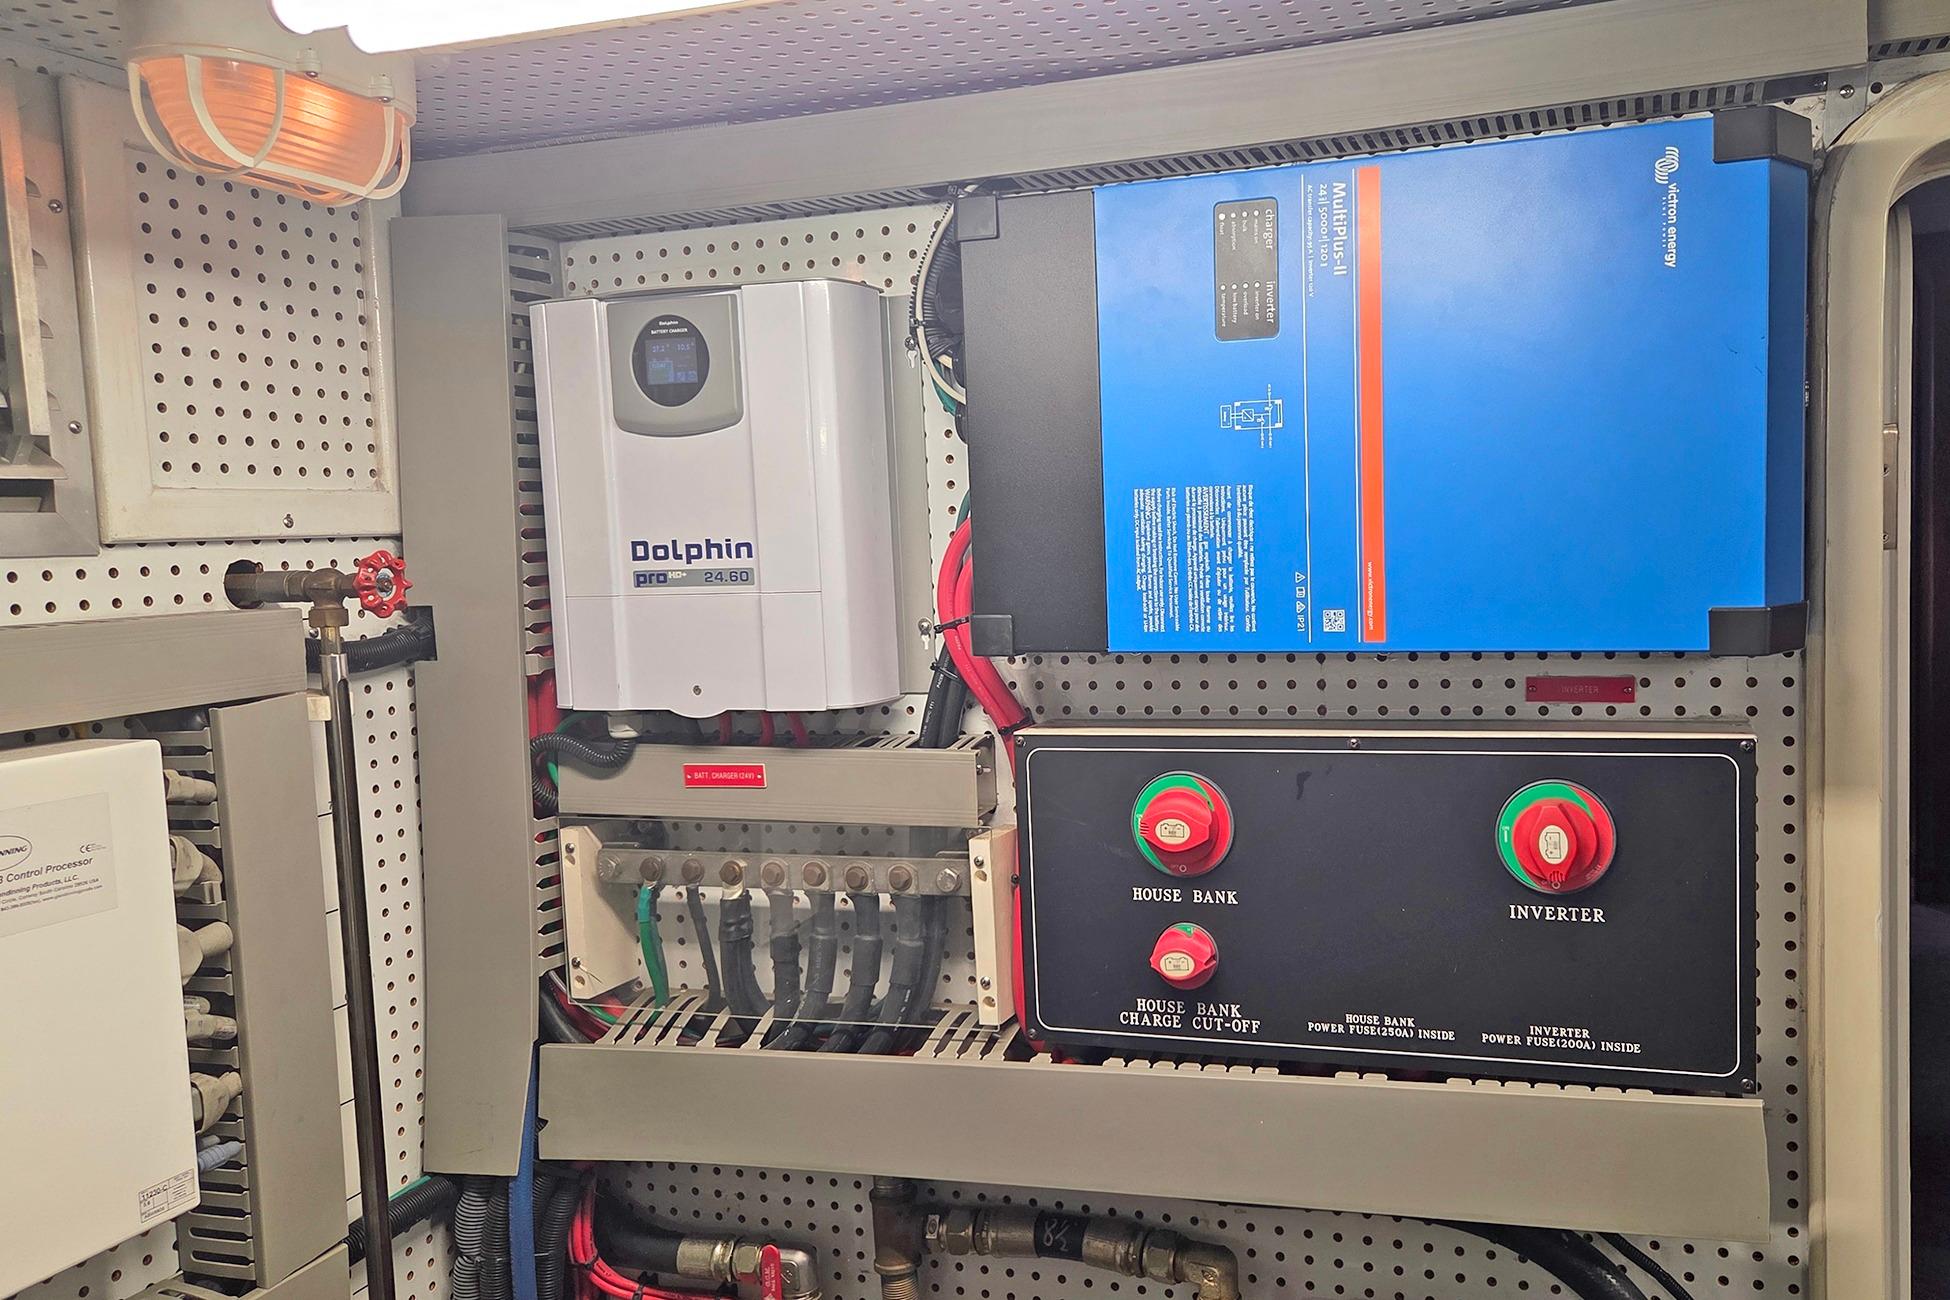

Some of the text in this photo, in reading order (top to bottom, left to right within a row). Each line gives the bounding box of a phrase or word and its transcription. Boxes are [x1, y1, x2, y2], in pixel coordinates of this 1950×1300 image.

[1263, 209, 1274, 249] charger
[1333, 183, 1347, 275] MultiPlus-II
[1665, 183, 1679, 267] victron energy
[1266, 281, 1275, 323] inverter
[631, 538, 753, 564] Dolphin
[704, 571, 749, 582] 24.60
[7, 867, 43, 882] Control
[46, 858, 93, 874] Processor
[1132, 887, 1238, 904] HOUSE BANK
[1509, 904, 1606, 923] INVERTER
[1136, 998, 1242, 1018] HOUSE BANK
[1120, 1011, 1261, 1034] CHARGE CUT-OFF
[1308, 1021, 1456, 1041] POWER FUSE(250A) INSIDE
[1345, 1014, 1415, 1028] HOUSE BANK
[1529, 1026, 1590, 1039] INVERTER
[1481, 1033, 1641, 1054] POWER FUSE(200A) INSIDE
